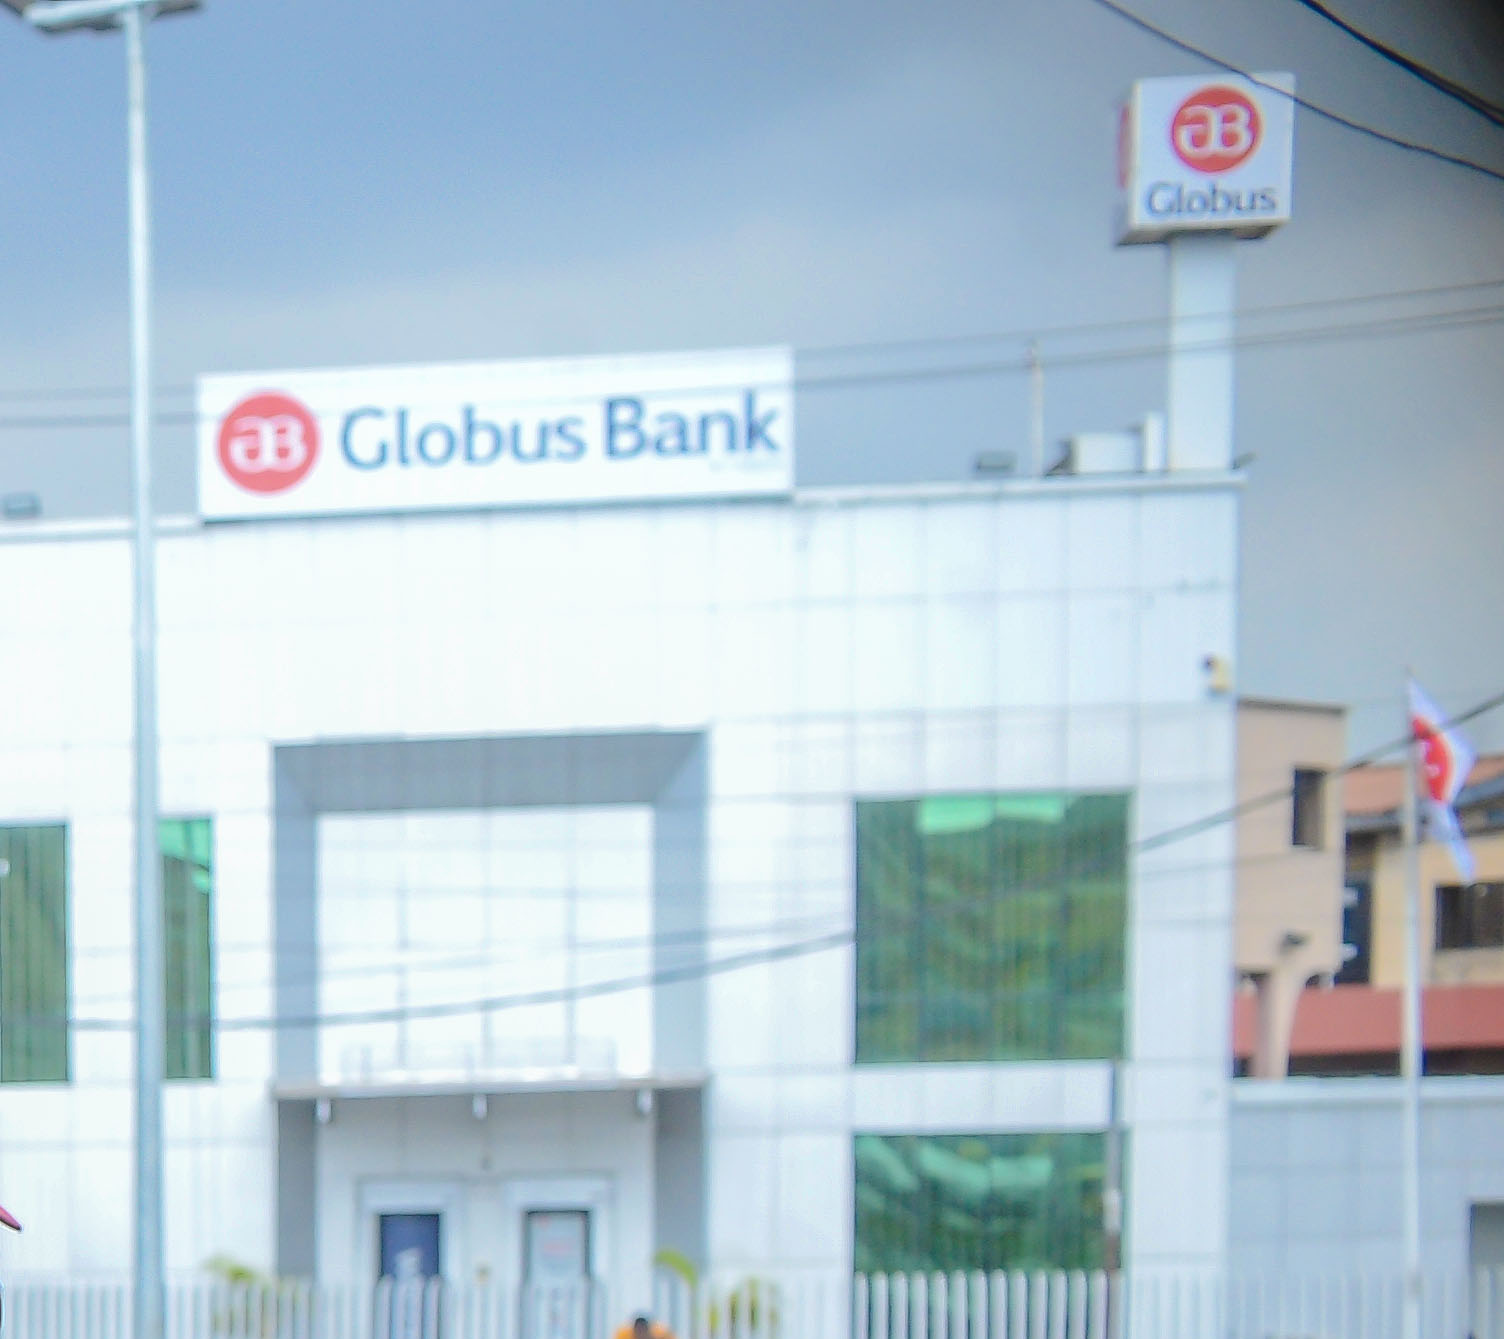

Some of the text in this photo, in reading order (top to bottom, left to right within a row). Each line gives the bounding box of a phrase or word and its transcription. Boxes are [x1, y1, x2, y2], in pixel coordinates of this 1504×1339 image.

[1145, 181, 1277, 217] Globus
[339, 403, 587, 471] Globus
[603, 388, 780, 460] Bank
